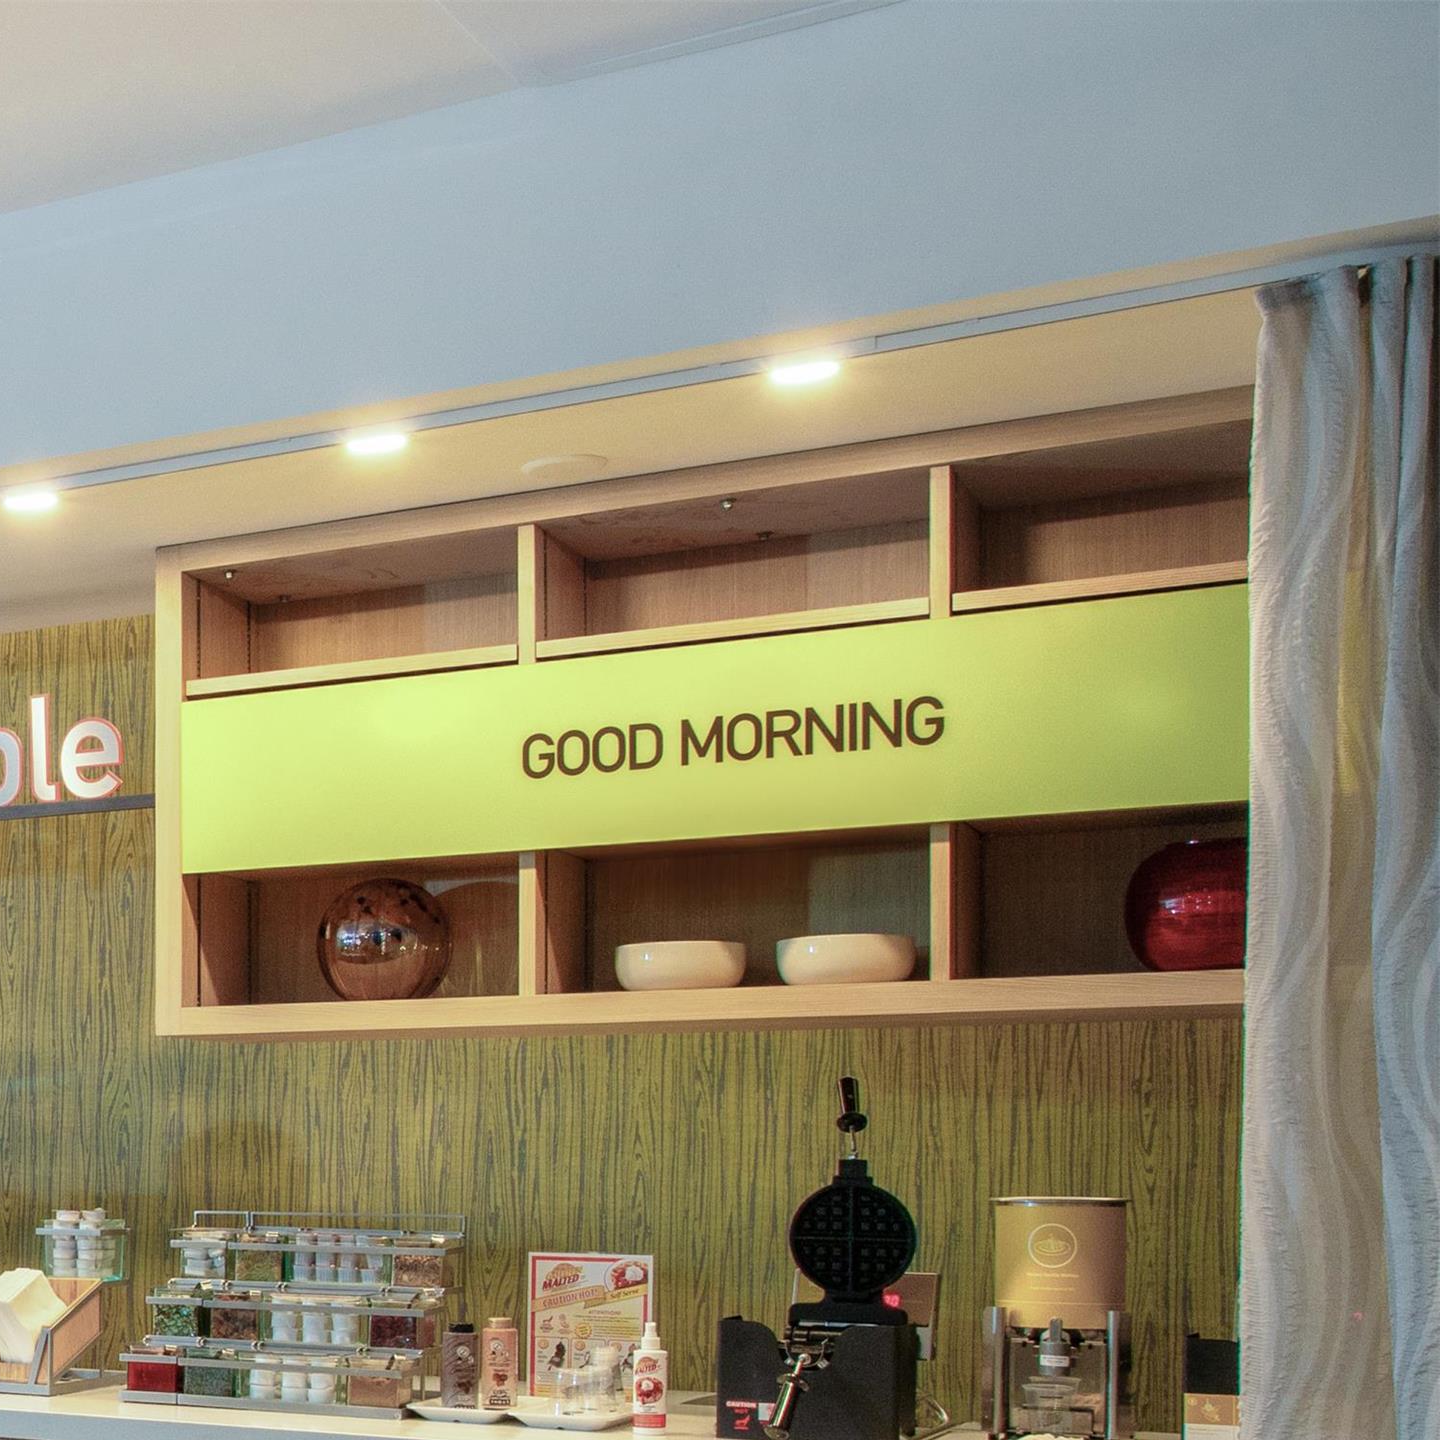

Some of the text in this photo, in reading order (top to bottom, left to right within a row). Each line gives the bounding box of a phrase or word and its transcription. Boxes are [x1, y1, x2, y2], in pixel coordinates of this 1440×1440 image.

[521, 695, 946, 780] GOOD MORNING
[541, 1273, 580, 1292] MALTED
[542, 1292, 578, 1309] CAUTION
